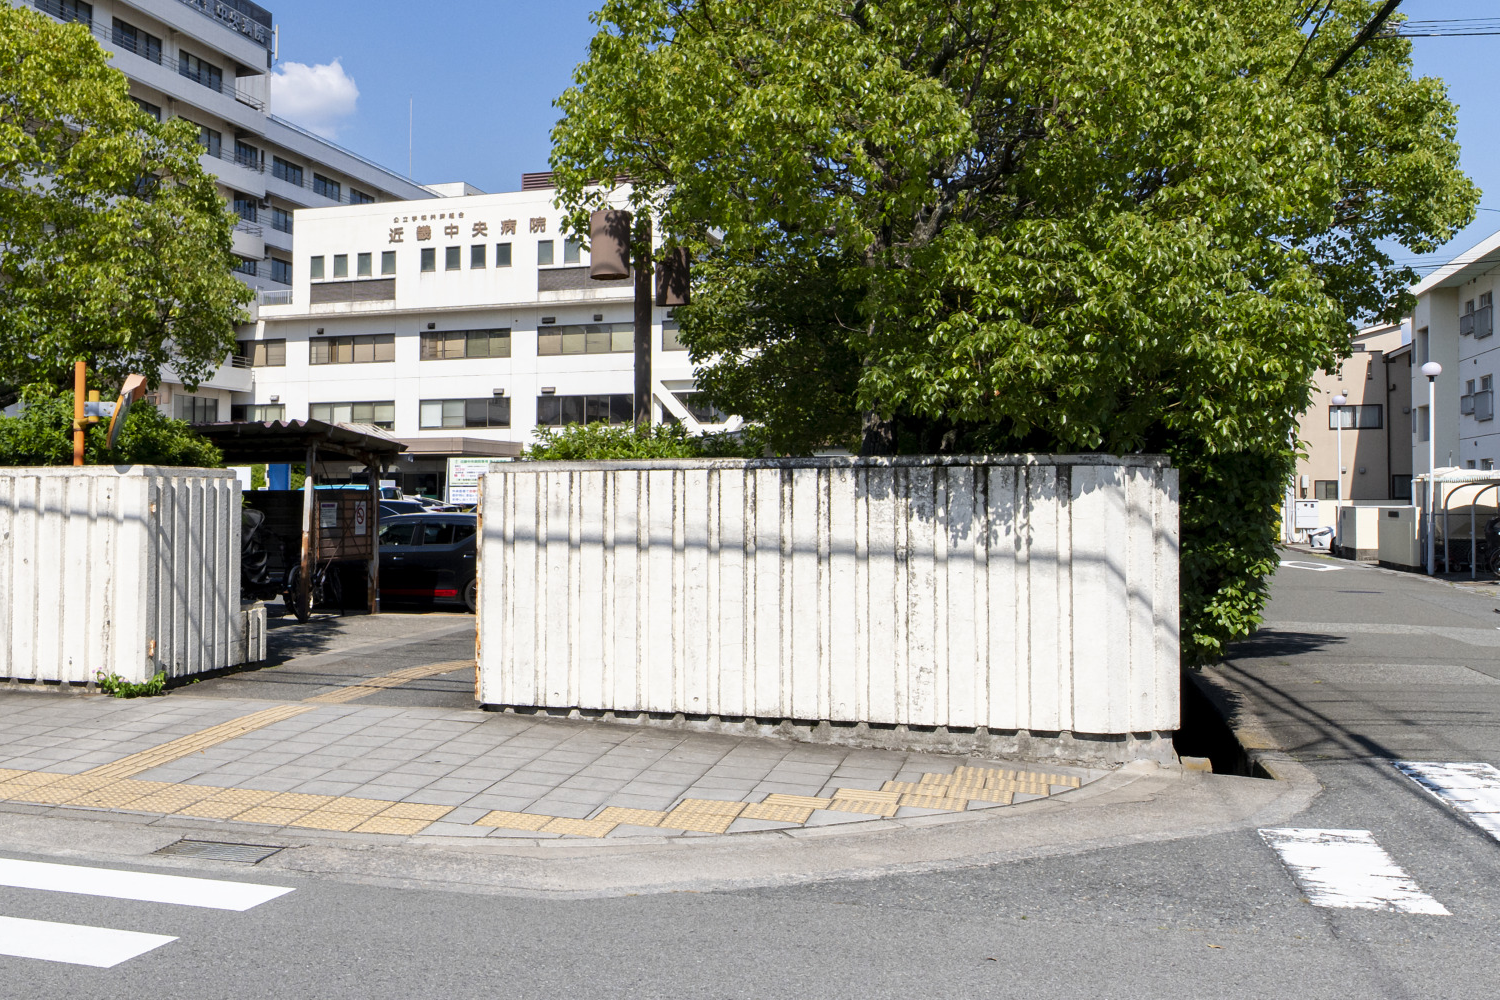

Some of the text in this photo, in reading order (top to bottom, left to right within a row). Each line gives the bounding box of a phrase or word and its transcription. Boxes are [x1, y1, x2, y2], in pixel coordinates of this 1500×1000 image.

[393, 211, 465, 224] 公立学校共済組合
[388, 216, 547, 244] 近畿中央病院
